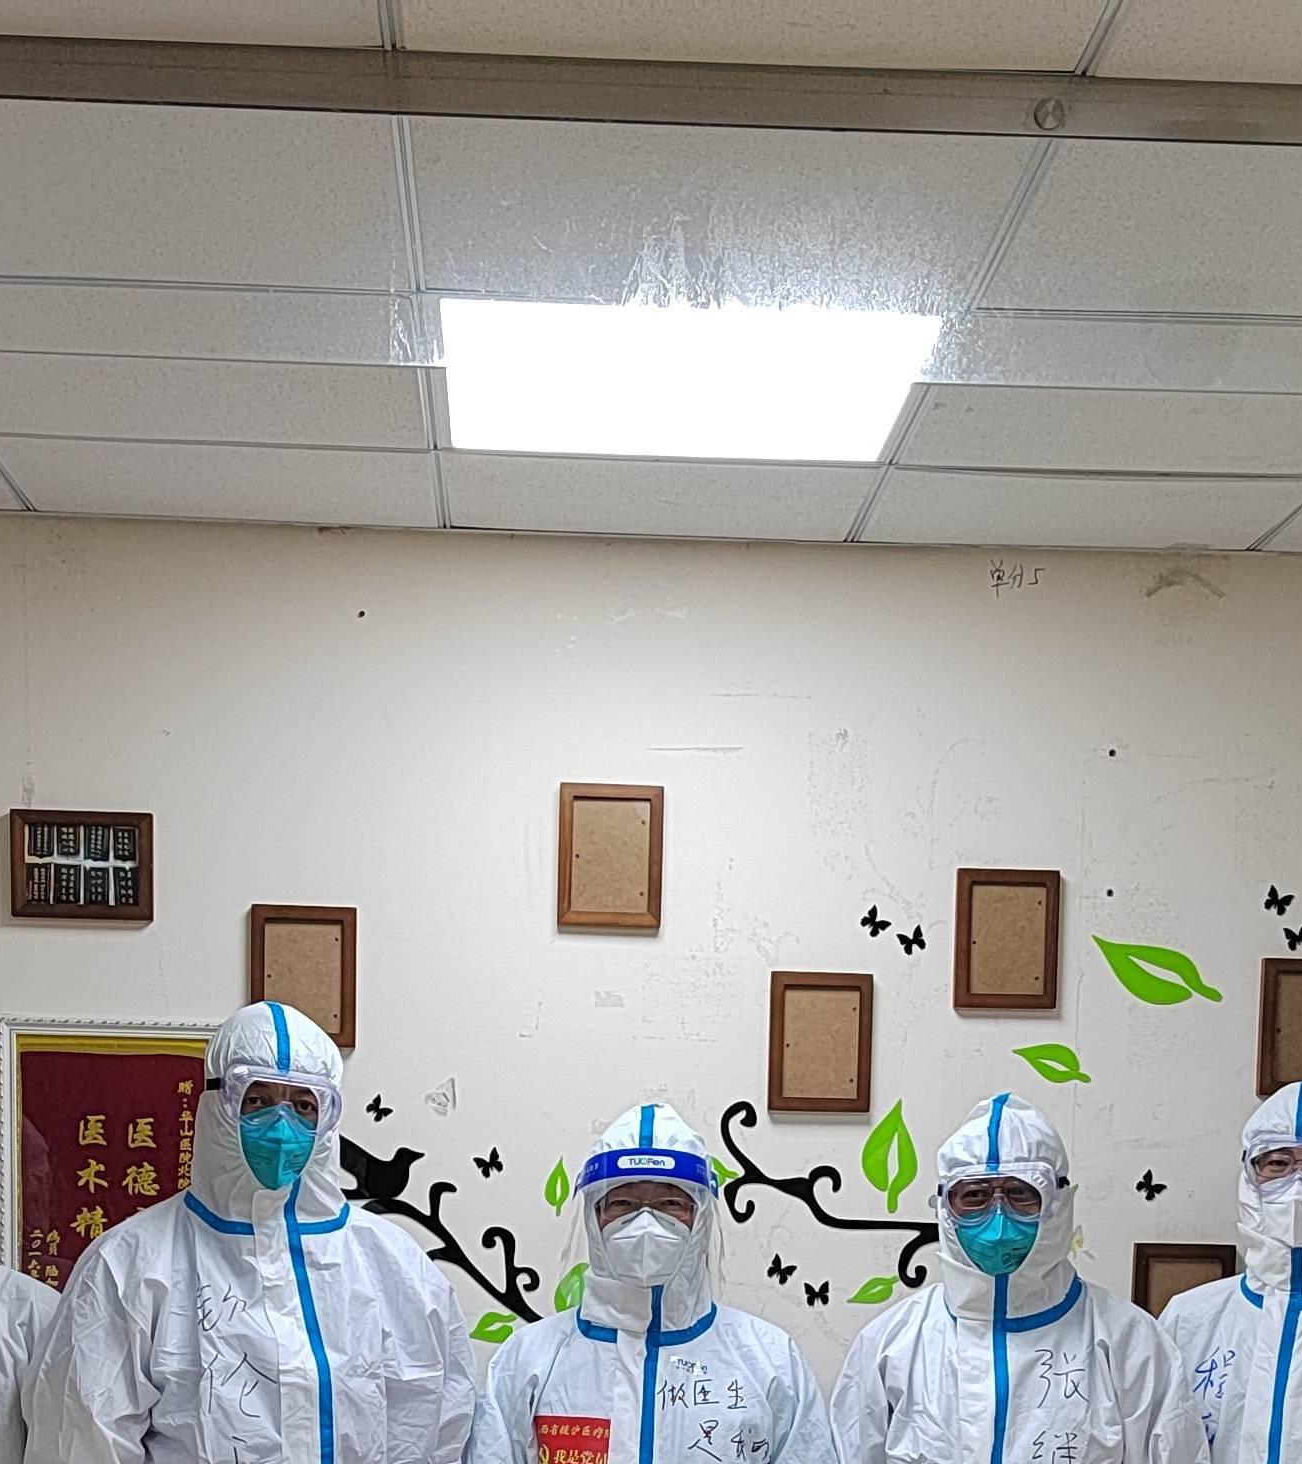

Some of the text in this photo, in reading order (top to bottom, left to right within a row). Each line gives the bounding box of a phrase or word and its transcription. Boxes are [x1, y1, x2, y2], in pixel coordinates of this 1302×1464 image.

[70, 1114, 109, 1240] 医术精
[122, 1117, 161, 1212] 医德
[657, 1379, 748, 1411] 做医生
